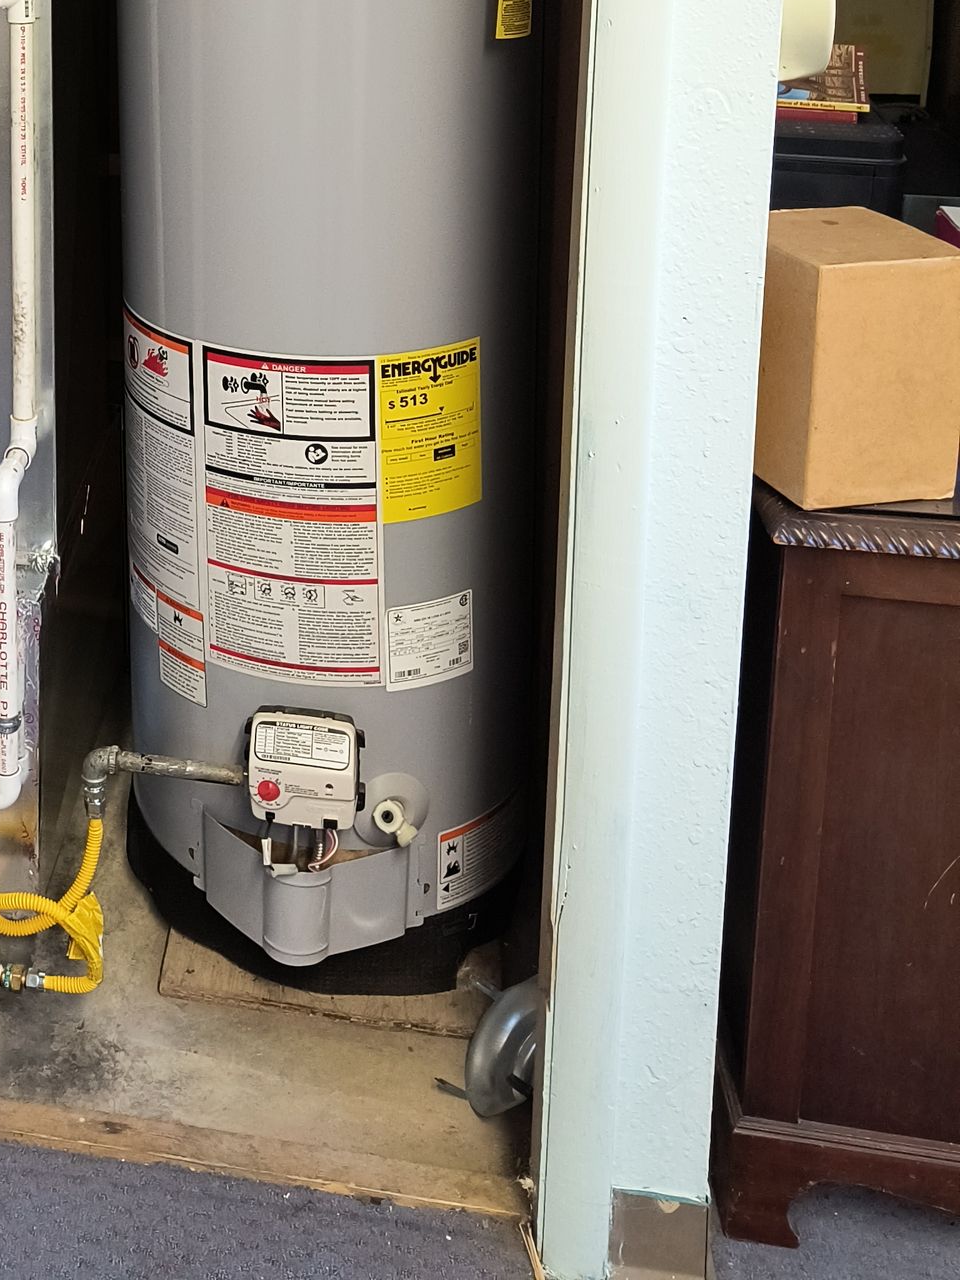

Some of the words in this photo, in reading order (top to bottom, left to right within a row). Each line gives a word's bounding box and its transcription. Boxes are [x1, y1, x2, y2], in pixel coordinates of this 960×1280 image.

[271, 364, 306, 373] DANGER
[399, 393, 428, 408] 513
[0, 601, 8, 690] CHARLOTTE
[0, 700, 8, 740] PIE
